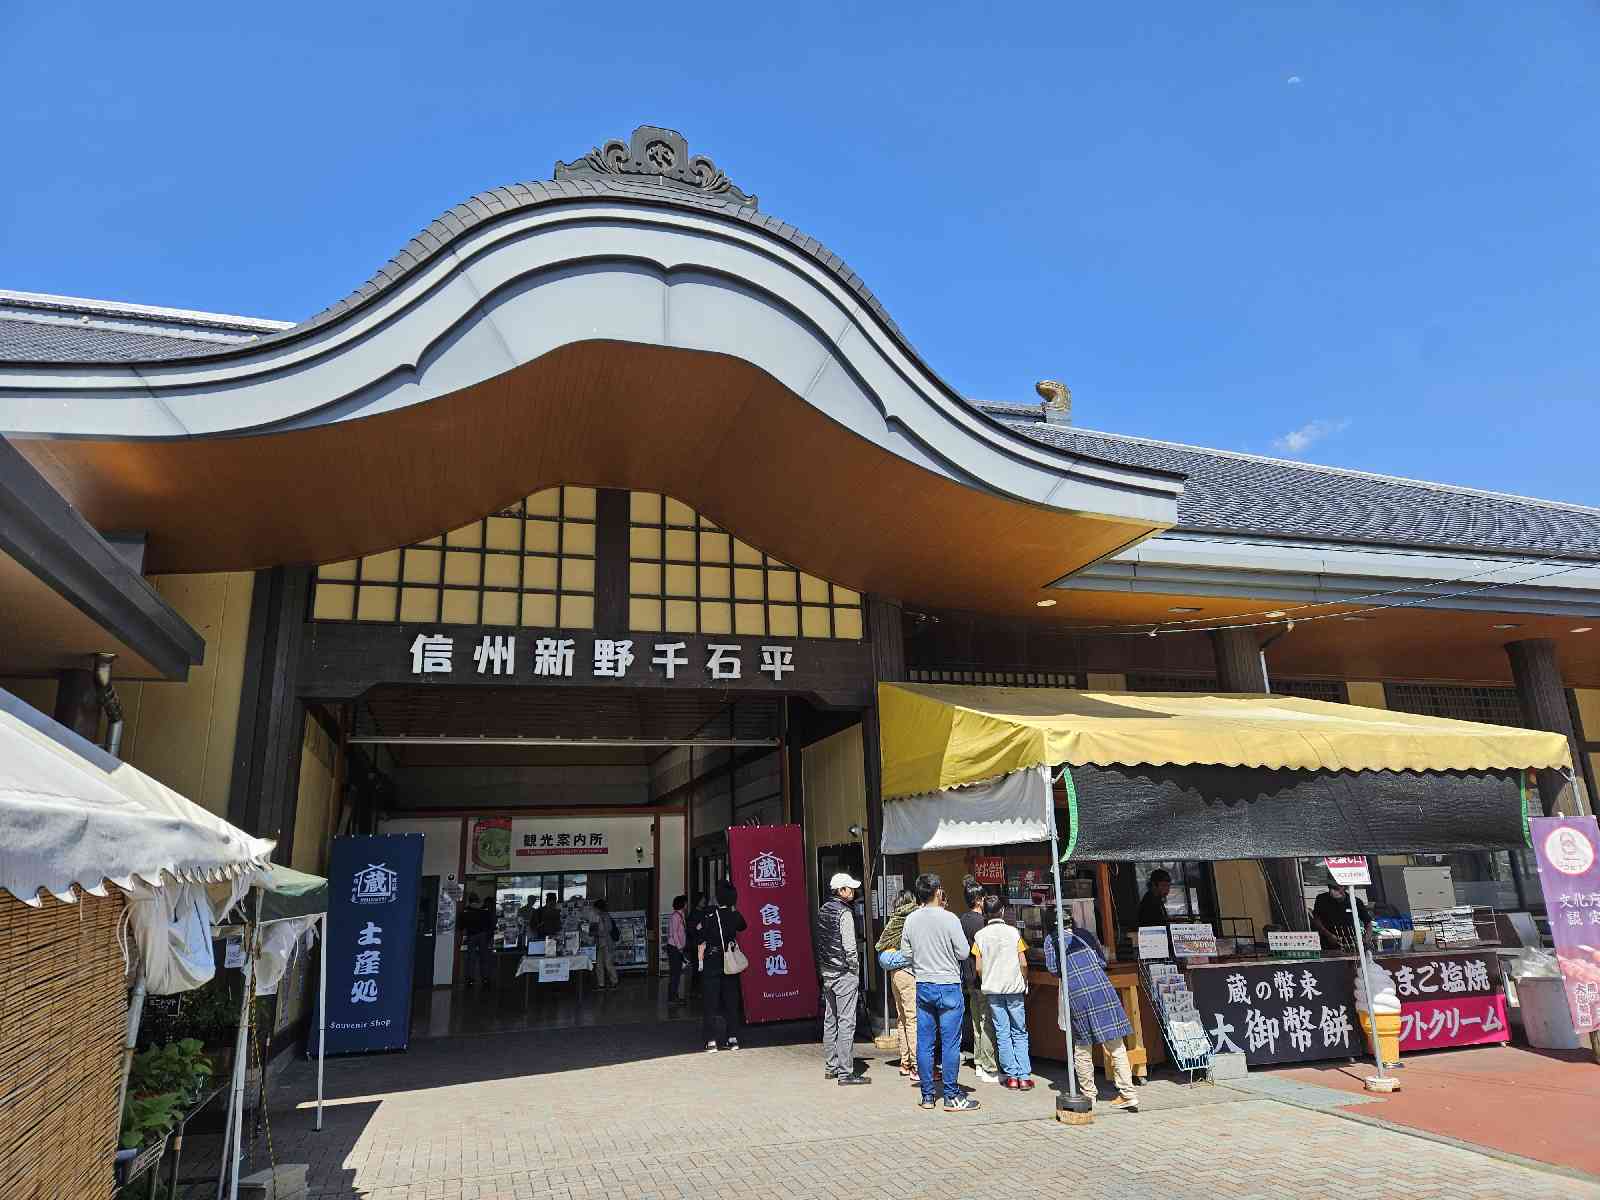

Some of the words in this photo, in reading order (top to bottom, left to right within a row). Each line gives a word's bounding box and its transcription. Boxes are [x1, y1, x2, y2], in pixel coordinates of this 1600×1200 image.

[410, 633, 795, 682] 信州新野千石平
[523, 833, 603, 848] 観光案内所
[759, 903, 789, 977] 食事処
[350, 921, 383, 1004] 土産処
[1384, 960, 1491, 996] まご塩焼
[329, 1021, 368, 1030] Souvenir
[1208, 1005, 1354, 1055] 大御幣餅
[1399, 1006, 1503, 1041] フトクリーム
